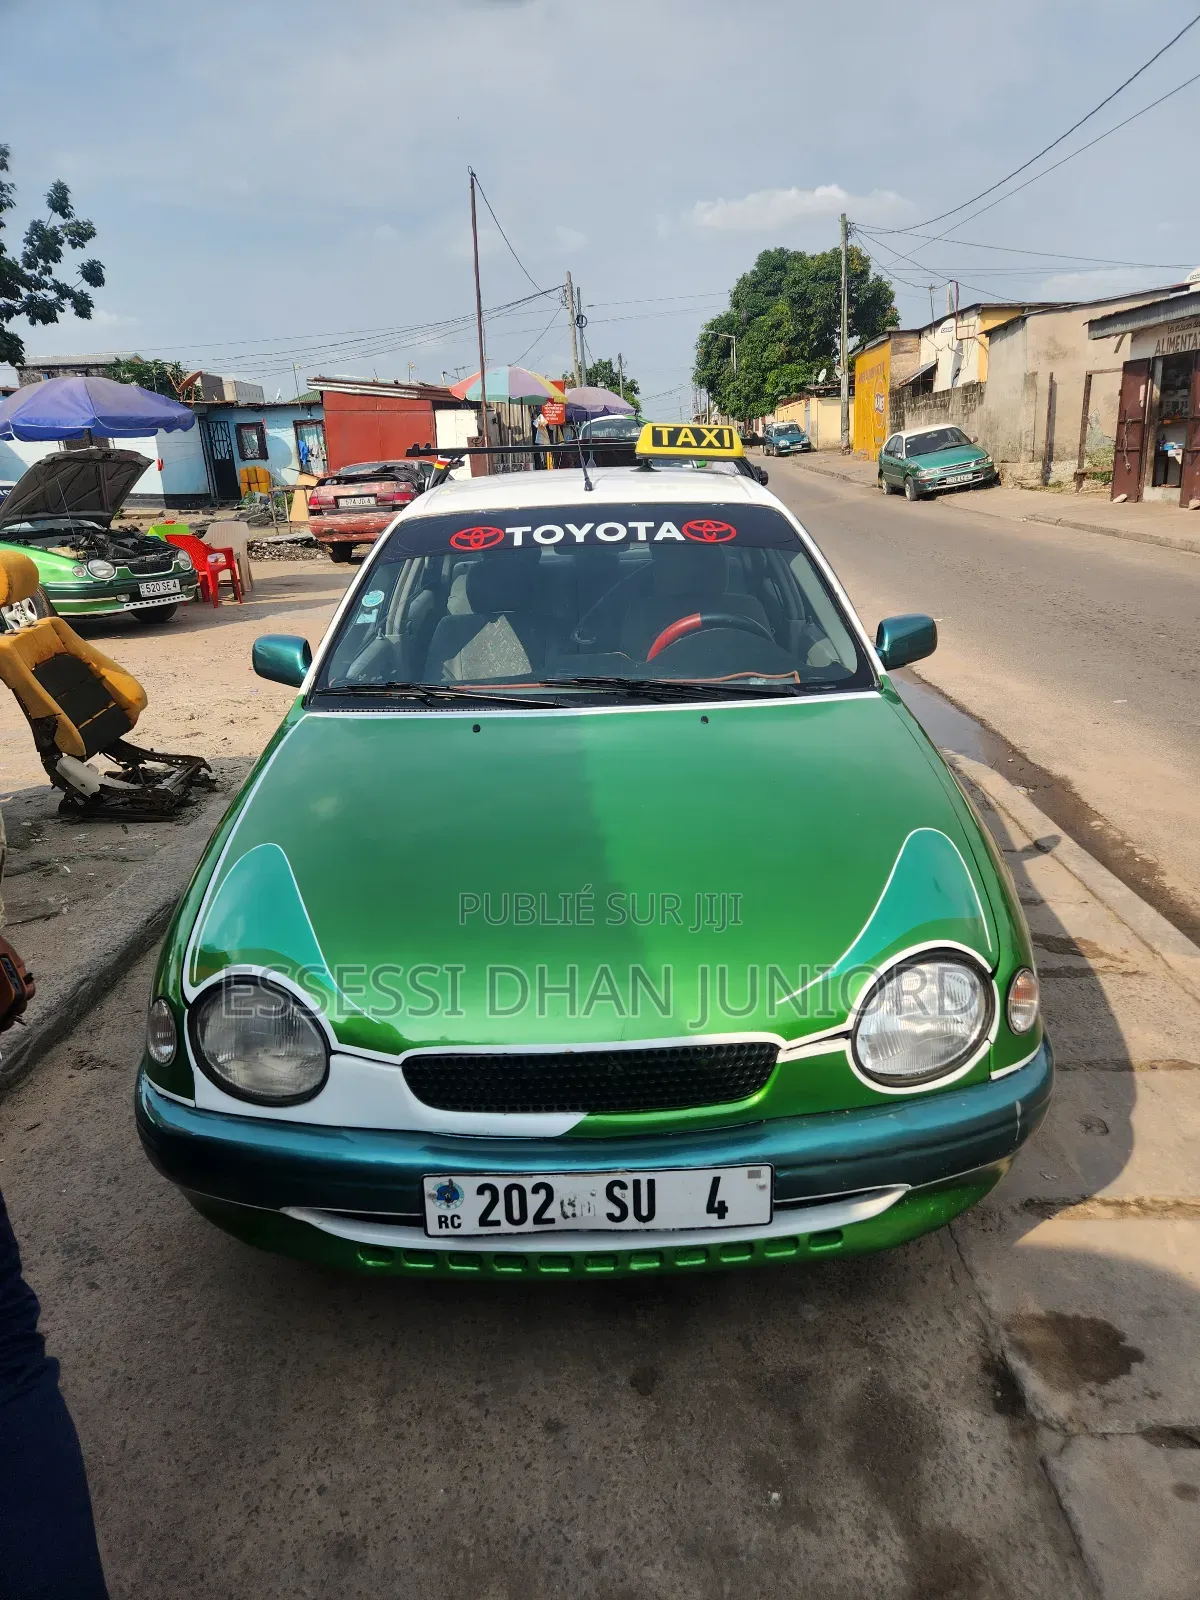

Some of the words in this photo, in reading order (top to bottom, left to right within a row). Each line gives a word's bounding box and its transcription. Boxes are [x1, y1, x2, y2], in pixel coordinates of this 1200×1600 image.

[655, 427, 731, 448] TAXI
[505, 521, 686, 547] TOYOTA
[145, 583, 161, 593] 520
[162, 581, 172, 591] SE
[605, 1178, 656, 1224] SU
[706, 1175, 729, 1220] 4
[437, 1214, 462, 1229] RC
